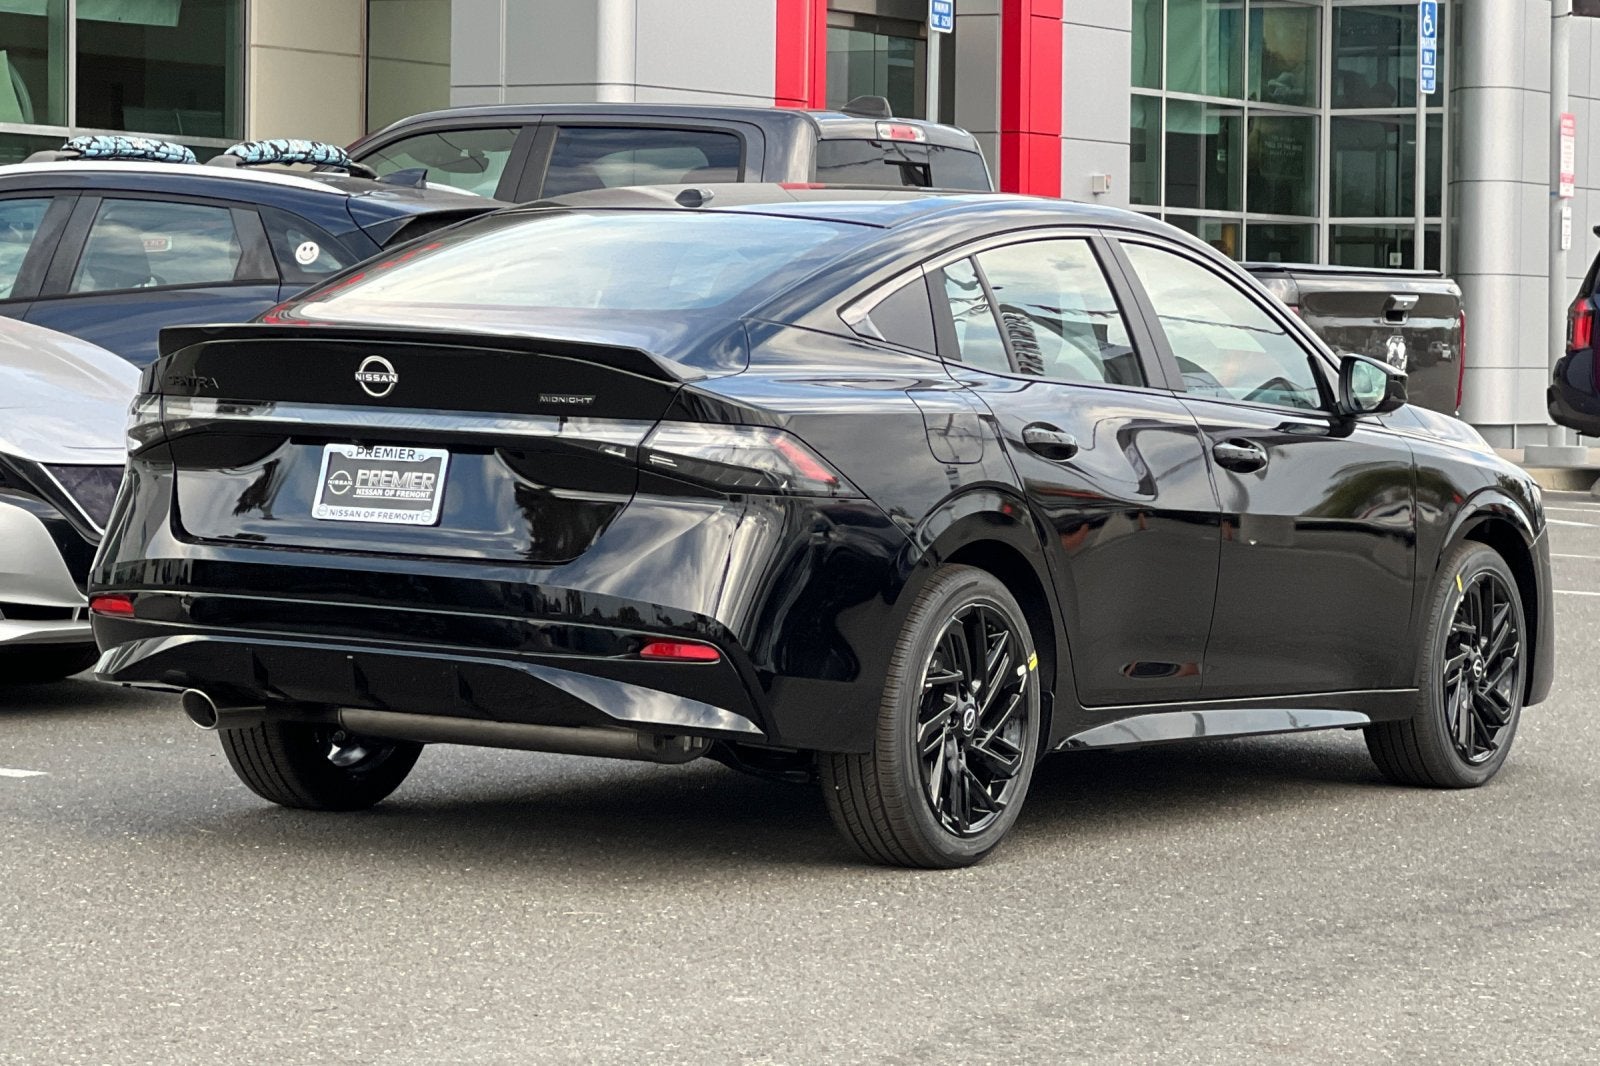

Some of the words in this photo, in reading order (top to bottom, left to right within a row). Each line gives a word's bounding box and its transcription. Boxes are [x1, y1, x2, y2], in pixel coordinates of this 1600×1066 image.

[355, 373, 398, 383] NISSAN
[539, 395, 593, 404] MIDNIGHT
[355, 446, 416, 460] PREMIER
[355, 469, 436, 489] PREMIER
[355, 488, 384, 496] NISSAN
[396, 490, 431, 498] FREMONT
[329, 508, 361, 518] NISSAN
[363, 511, 375, 519] OF
[377, 511, 420, 521] FREMONT
